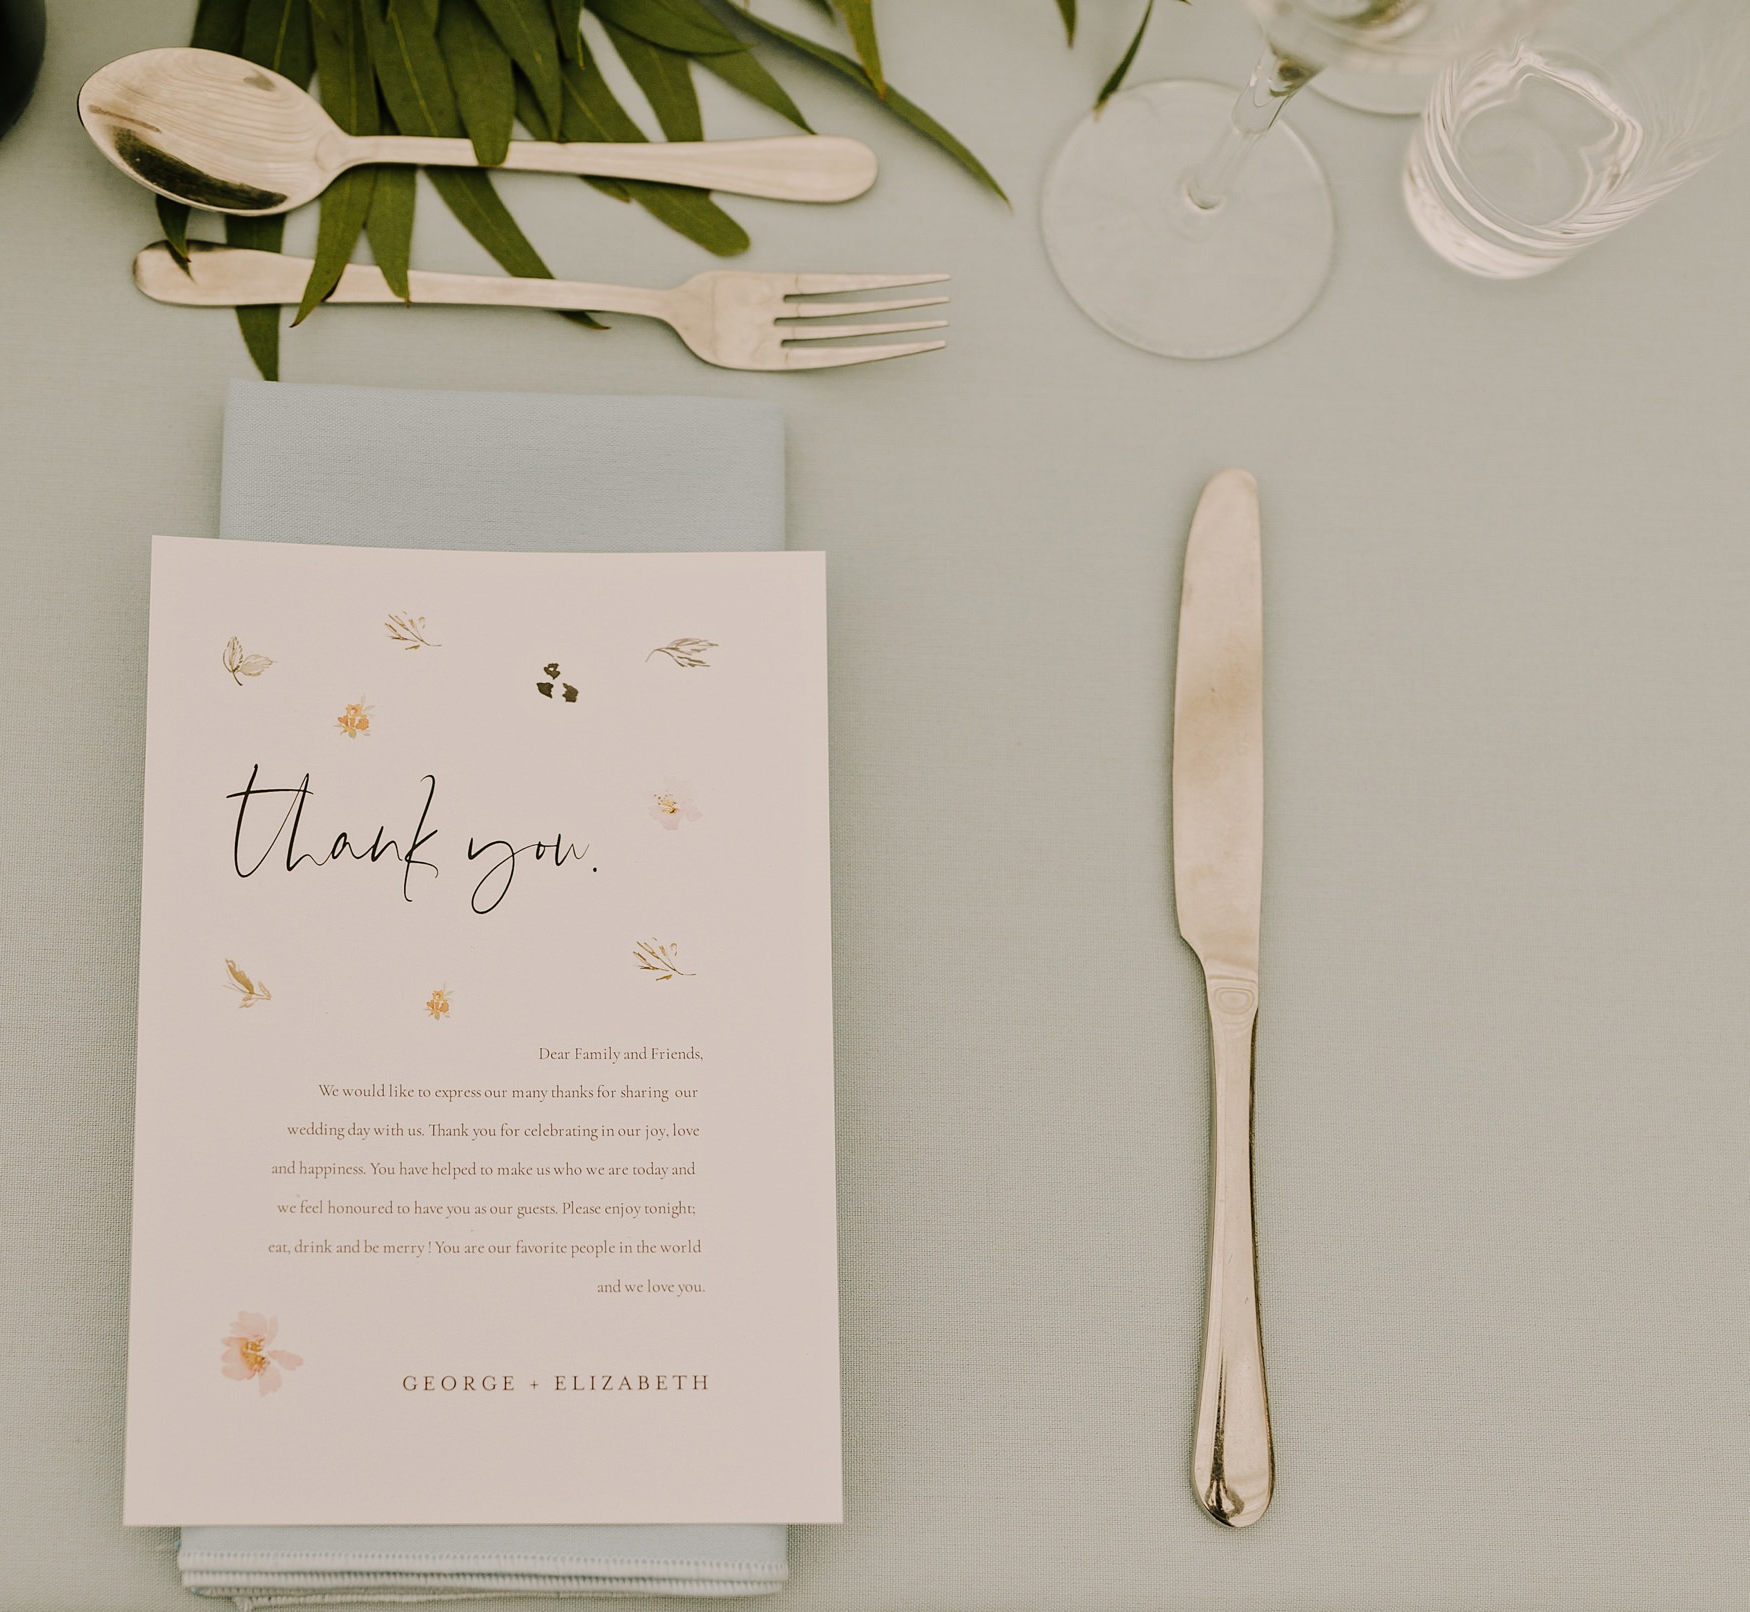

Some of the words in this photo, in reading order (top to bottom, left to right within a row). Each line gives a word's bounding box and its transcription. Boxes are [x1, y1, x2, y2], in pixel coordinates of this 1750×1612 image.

[225, 762, 440, 903] thank
[467, 832, 598, 916] you.
[538, 1047, 571, 1060] Dear
[574, 1046, 621, 1065] Family
[623, 1045, 648, 1060] and
[651, 1045, 704, 1061] Friends,
[318, 1083, 339, 1097] We
[342, 1083, 386, 1098] would
[388, 1083, 415, 1098] like
[417, 1088, 432, 1098] to
[434, 1088, 482, 1103] express
[484, 1089, 508, 1099] our
[511, 1089, 548, 1103] many
[551, 1084, 594, 1099] thanks
[597, 1084, 617, 1099] for
[620, 1084, 670, 1103] sharing
[674, 1089, 699, 1098] our
[287, 1121, 346, 1141] wedding
[347, 1121, 371, 1141] day
[373, 1121, 404, 1137] with
[407, 1127, 425, 1137] us.
[428, 1122, 470, 1137] Thank
[471, 1127, 497, 1142] you
[500, 1122, 521, 1137] for
[523, 1122, 599, 1142] celebrating
[601, 1124, 615, 1137] in
[617, 1127, 642, 1137] our
[645, 1124, 670, 1142] joy,
[672, 1122, 700, 1137] love
[271, 1159, 297, 1175] and
[299, 1160, 367, 1180] happiness.
[369, 1162, 396, 1176] You
[399, 1161, 429, 1176] have
[431, 1161, 477, 1181] helped
[480, 1166, 494, 1176] to
[497, 1161, 533, 1176] make
[536, 1166, 551, 1176] us
[553, 1161, 583, 1176] who
[585, 1166, 605, 1176] we
[608, 1166, 629, 1176] are
[632, 1161, 669, 1180] today
[671, 1161, 697, 1176] and
[277, 1204, 297, 1214] we
[300, 1199, 323, 1214] feel
[327, 1199, 394, 1215] honoured
[397, 1205, 411, 1215] to
[414, 1200, 444, 1215] have
[445, 1205, 471, 1219] you
[474, 1205, 487, 1215] as
[489, 1205, 514, 1215] our
[516, 1205, 558, 1220] guests.
[562, 1200, 602, 1215] Please
[604, 1202, 642, 1220] enjoy
[267, 1243, 291, 1255] eat,
[294, 1238, 332, 1254] drink
[335, 1239, 361, 1254] and
[363, 1239, 380, 1254] be
[434, 1240, 461, 1254] You
[464, 1244, 485, 1254] are
[487, 1244, 512, 1254] our
[515, 1239, 568, 1254] favorite
[570, 1239, 616, 1259] people
[619, 1241, 633, 1254] in
[636, 1239, 657, 1254] the
[659, 1238, 702, 1254] world
[597, 1278, 622, 1293] and
[624, 1284, 644, 1293] we
[647, 1278, 675, 1293] love
[676, 1283, 706, 1298] you.
[402, 1374, 515, 1392] GEORGE
[553, 1374, 709, 1392] ELIZABETH
